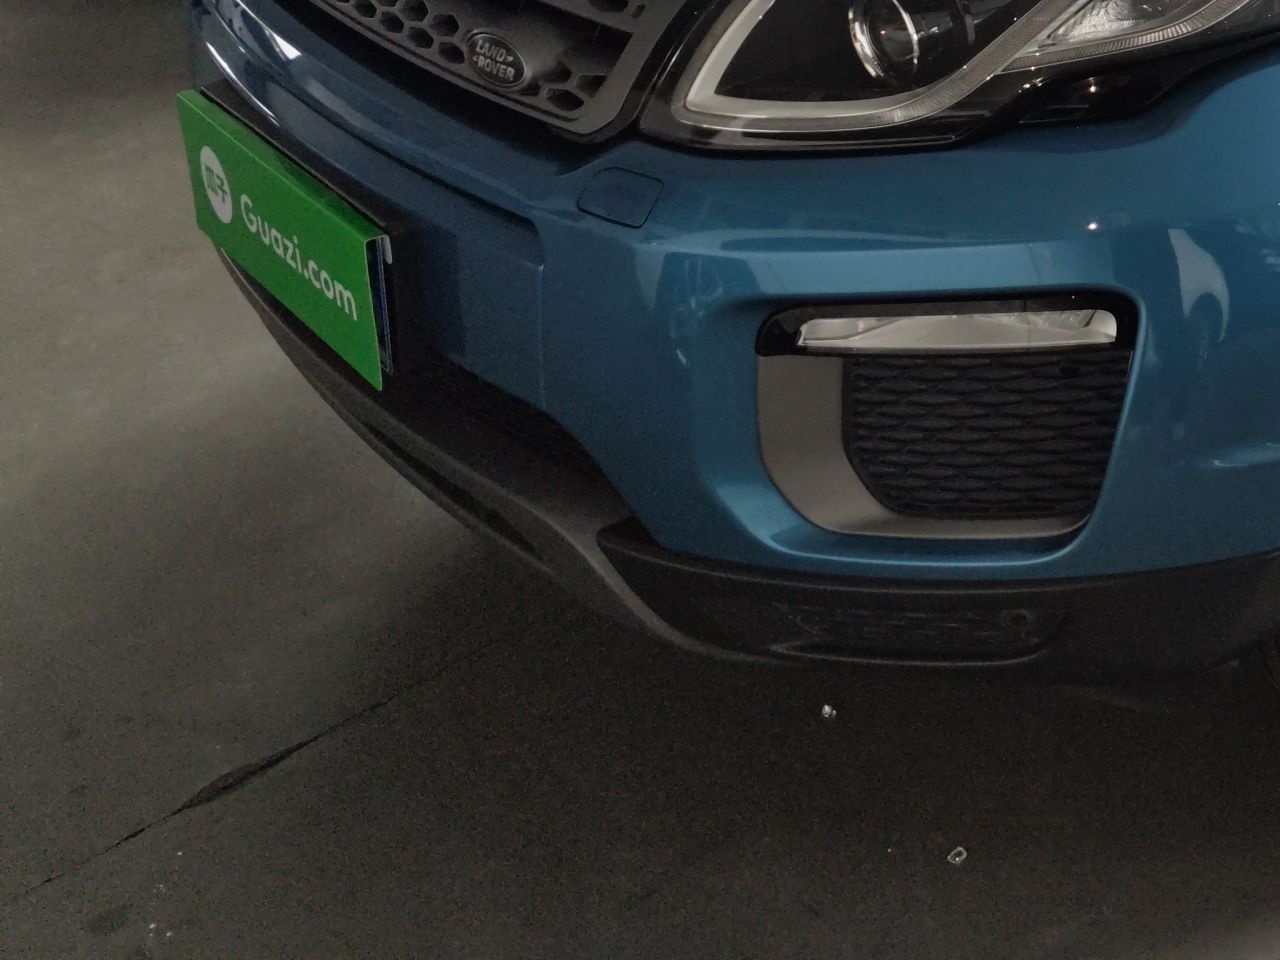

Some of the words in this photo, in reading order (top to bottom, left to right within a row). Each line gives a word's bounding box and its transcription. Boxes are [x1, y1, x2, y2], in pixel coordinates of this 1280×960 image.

[476, 40, 507, 62] LAND
[478, 57, 515, 81] ROVER
[241, 194, 358, 321] Guazi.com
